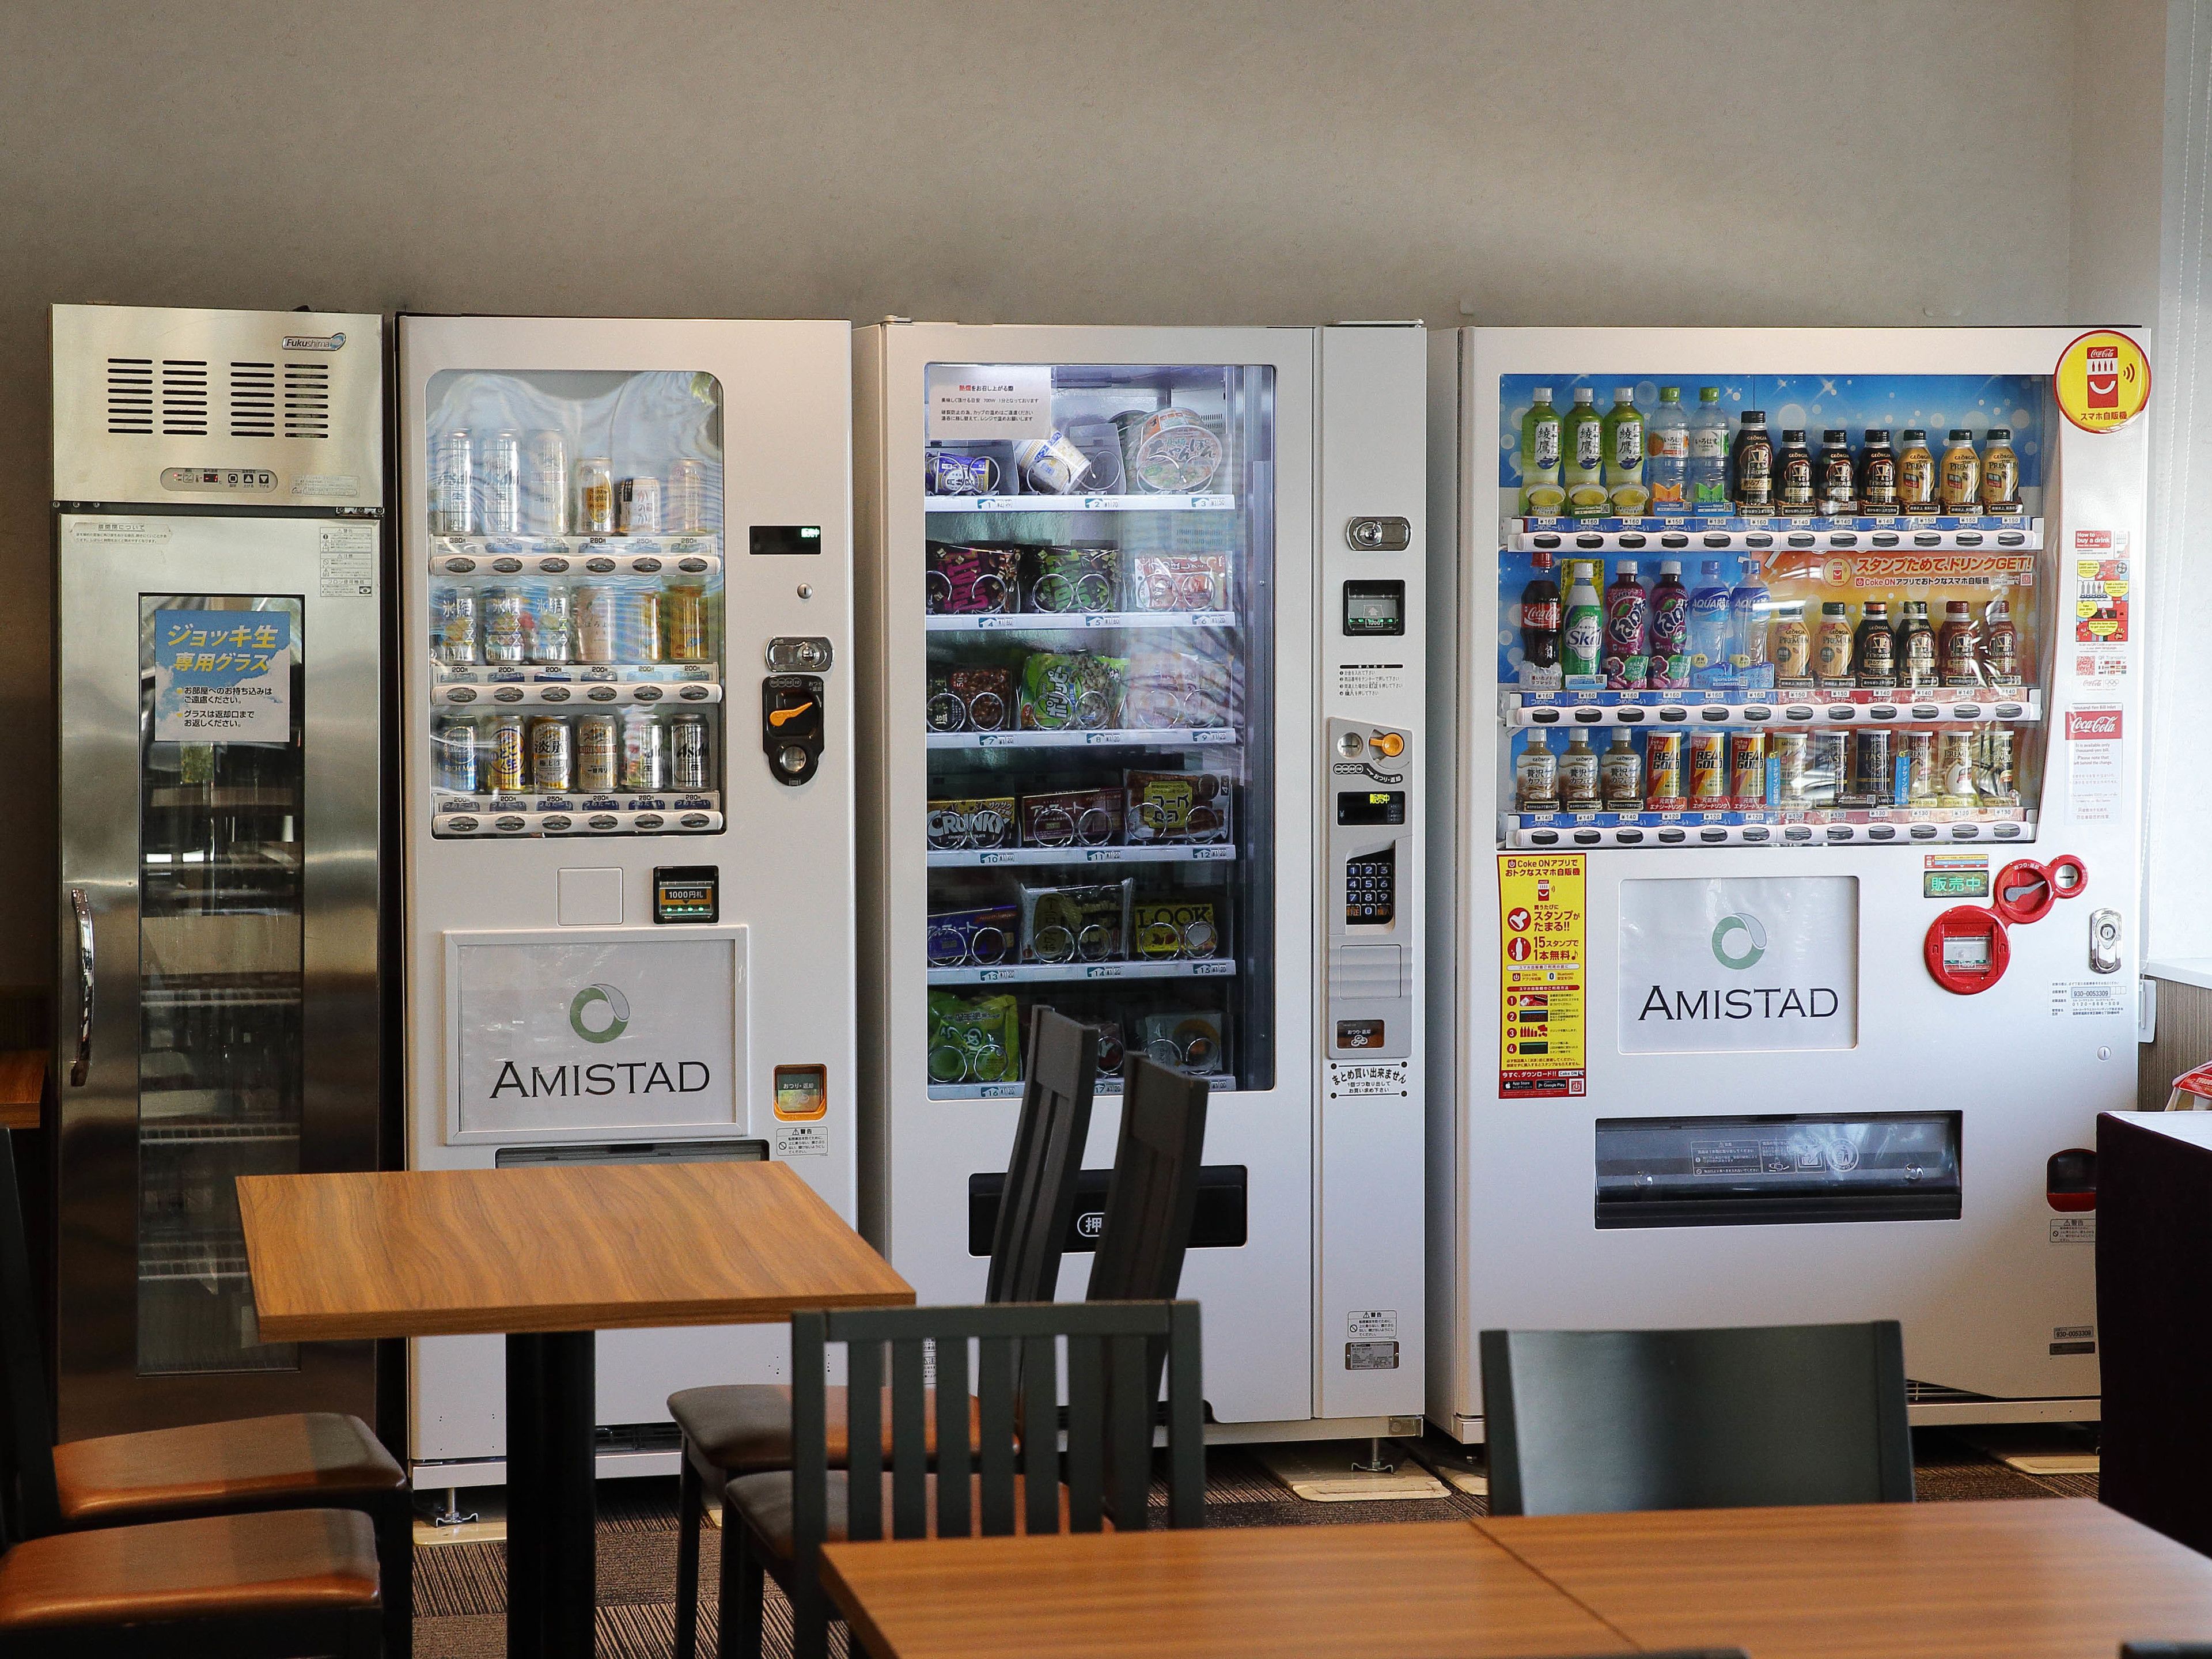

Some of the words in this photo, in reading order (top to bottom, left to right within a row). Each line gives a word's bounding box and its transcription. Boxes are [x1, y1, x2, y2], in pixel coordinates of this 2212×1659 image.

[286, 339, 332, 349] Fukushima
[2090, 348, 2115, 358] Coca-Cola
[2080, 411, 2127, 421] スマホ自販機
[1537, 427, 1551, 454] 綾鷹
[1579, 427, 1593, 454] 綾鷹
[1619, 427, 1633, 454] 綾鷹
[1857, 556, 2032, 572] スタンプためて、ドリンクGET!
[1610, 599, 1646, 644] Fanta
[1653, 598, 1688, 638] Fanta
[168, 623, 279, 649] ジョッキ生
[174, 652, 269, 672] 専用グラス
[184, 687, 272, 695] お部屋へのお持ち込みは
[184, 696, 242, 704] ご遠慮ください。
[184, 710, 255, 718] グラスは返却口まで
[184, 719, 241, 728] お返しください。
[2070, 715, 2119, 733] Coca-Cola
[1654, 751, 1680, 760] REAL
[1696, 751, 1723, 760] REAL
[1738, 751, 1763, 760] REAL
[1653, 760, 1679, 770] GOLD
[1695, 760, 1722, 769] GOLD
[1737, 760, 1763, 770] GOLD
[1369, 794, 1390, 804] 販売中
[927, 811, 1009, 837] CRUNKY
[1517, 859, 1537, 868] Coke
[1539, 859, 1578, 867] ONアプリで
[1365, 866, 1372, 874] 2
[1380, 866, 1388, 874] 3
[1505, 868, 1580, 876] おトクなスマホ自販機
[1931, 876, 1981, 892] 販売中
[1365, 893, 1372, 902] 8
[1137, 906, 1211, 929] LOOK
[1534, 911, 1580, 921] スタンプが
[1534, 922, 1570, 931] たまる!!
[1533, 936, 1578, 948] 15スタンプで
[1638, 985, 1839, 1021] AMISTAD
[1332, 1067, 1407, 1085] まとめ買い出来ません
[1502, 1070, 1556, 1078] 今すぐ、ダウンロード!!
[489, 1060, 711, 1099] AMISTAD
